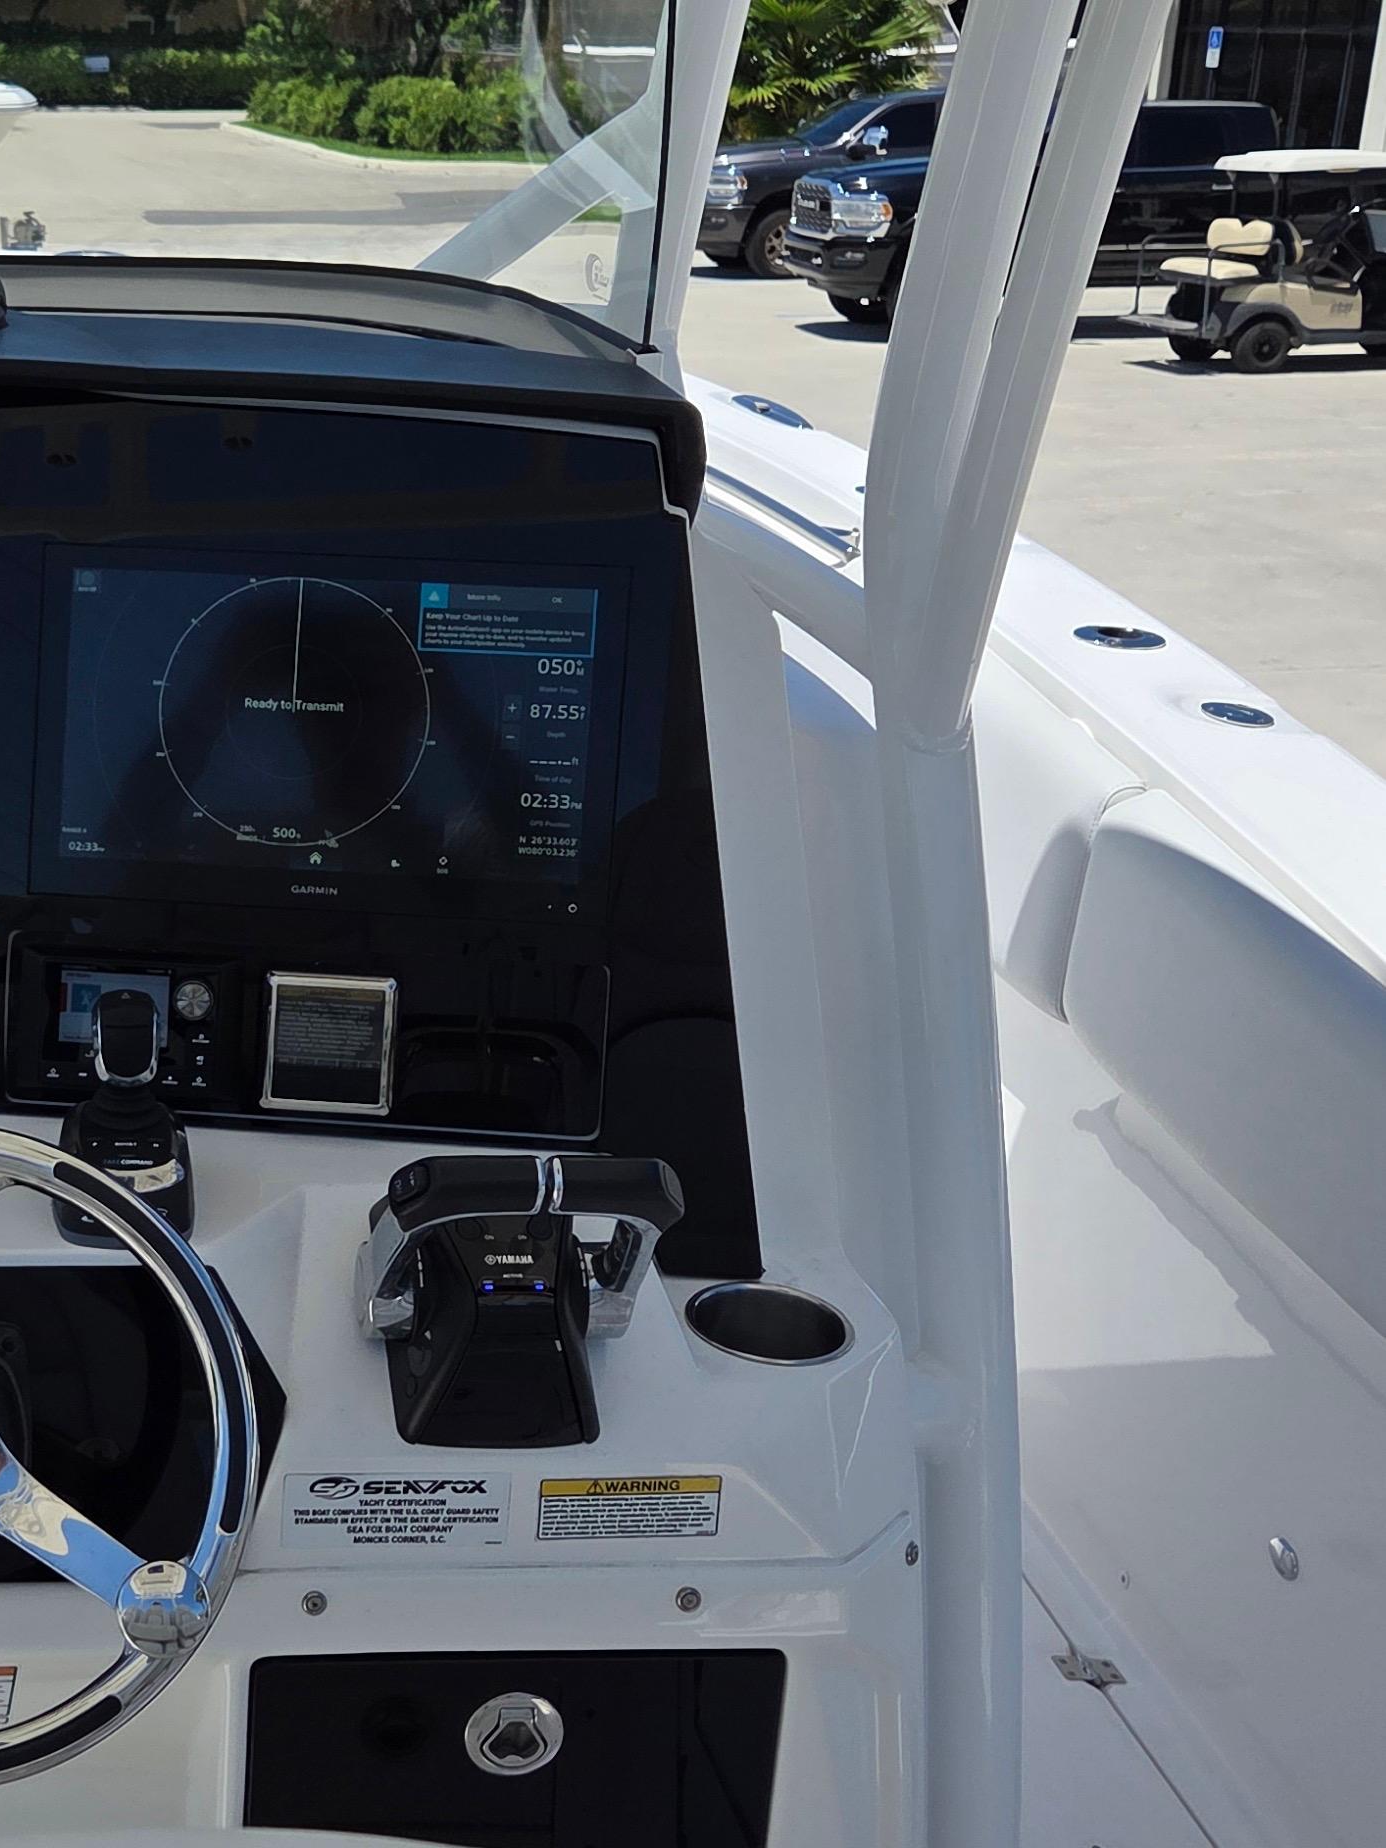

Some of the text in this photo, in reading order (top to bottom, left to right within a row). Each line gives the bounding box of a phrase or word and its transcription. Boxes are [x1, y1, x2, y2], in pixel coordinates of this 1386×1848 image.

[244, 697, 344, 713] Ready to Transmit
[518, 835, 527, 844] N
[68, 841, 106, 853] 02:33
[290, 884, 338, 896] GARMIN
[495, 1254, 535, 1265] YAMAHA
[604, 1479, 681, 1493] WARNING
[359, 1499, 447, 1507] YACHT CERTIFICATION
[294, 1508, 311, 1516] THIS
[311, 1508, 331, 1516] BOAT
[332, 1508, 368, 1516] COMPLIES
[369, 1508, 389, 1516] WITH
[390, 1508, 404, 1516] THE
[420, 1508, 444, 1516] COAST
[445, 1508, 471, 1516] GUARD
[472, 1508, 500, 1516] SAFETY
[294, 1516, 338, 1525] STANDARDS
[350, 1516, 378, 1525] EFFECT
[392, 1516, 406, 1525] THE
[407, 1516, 429, 1525] DATE
[429, 1516, 441, 1525] OF
[441, 1516, 499, 1525] CERTIFICATION
[346, 1525, 454, 1534] SEA FOX BOAT COMPANY
[353, 1535, 390, 1544] MONCKS
[391, 1535, 428, 1545] CORNER,
